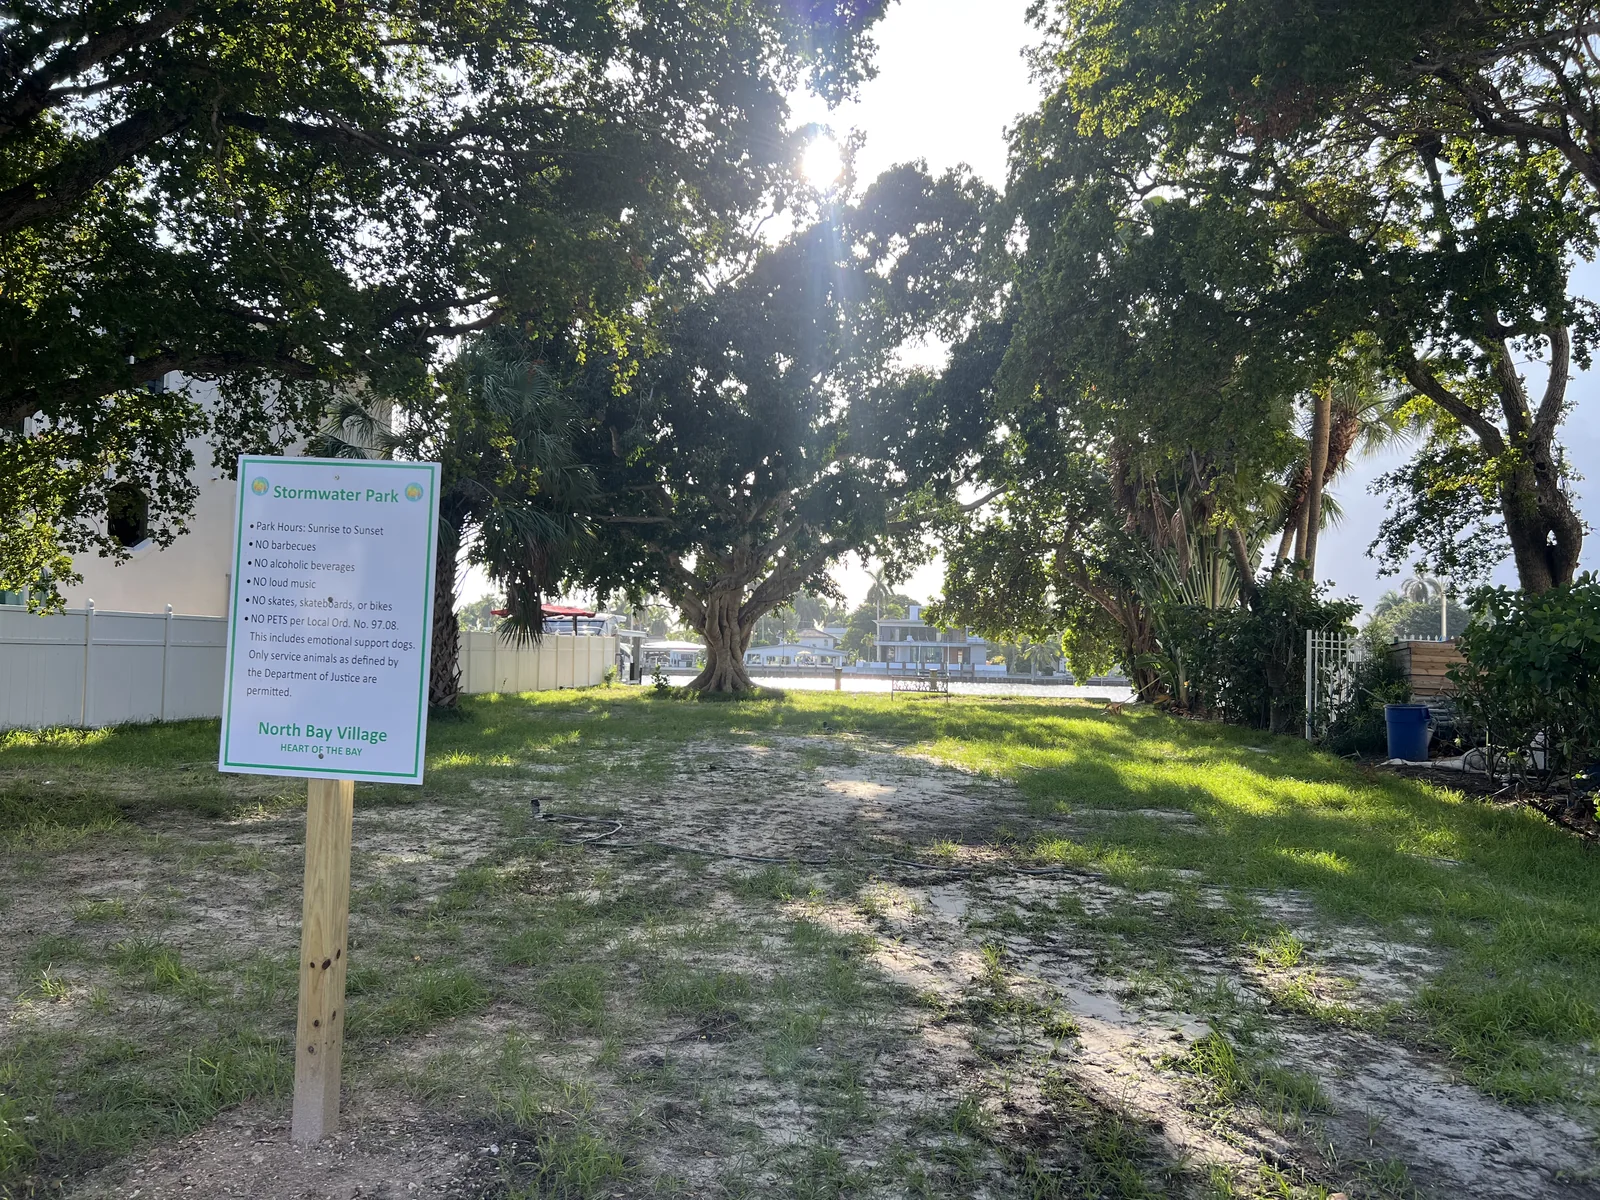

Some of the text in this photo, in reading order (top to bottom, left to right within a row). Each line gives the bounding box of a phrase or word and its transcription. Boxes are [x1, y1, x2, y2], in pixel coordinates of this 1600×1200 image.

[273, 485, 399, 502] Stormwater Park
[256, 522, 384, 535] Park Hours: Sunrise to Sunset
[256, 540, 316, 551] NO barbecues
[254, 559, 355, 572] NO alcoholic beverages
[253, 577, 316, 589] NO loud music
[252, 596, 392, 611] NO skates, skateboards, or bikes
[251, 614, 399, 630] NO PETS per Local Ord. No. 97.08.
[250, 632, 415, 650] This includes emotional support dogs.
[249, 650, 398, 668] Only service animals as defined by
[248, 668, 377, 683] the Department of Justice are
[247, 686, 292, 697] permitted.
[259, 722, 387, 744] North Bay Village
[280, 744, 363, 756] HEART OF THE BAY
